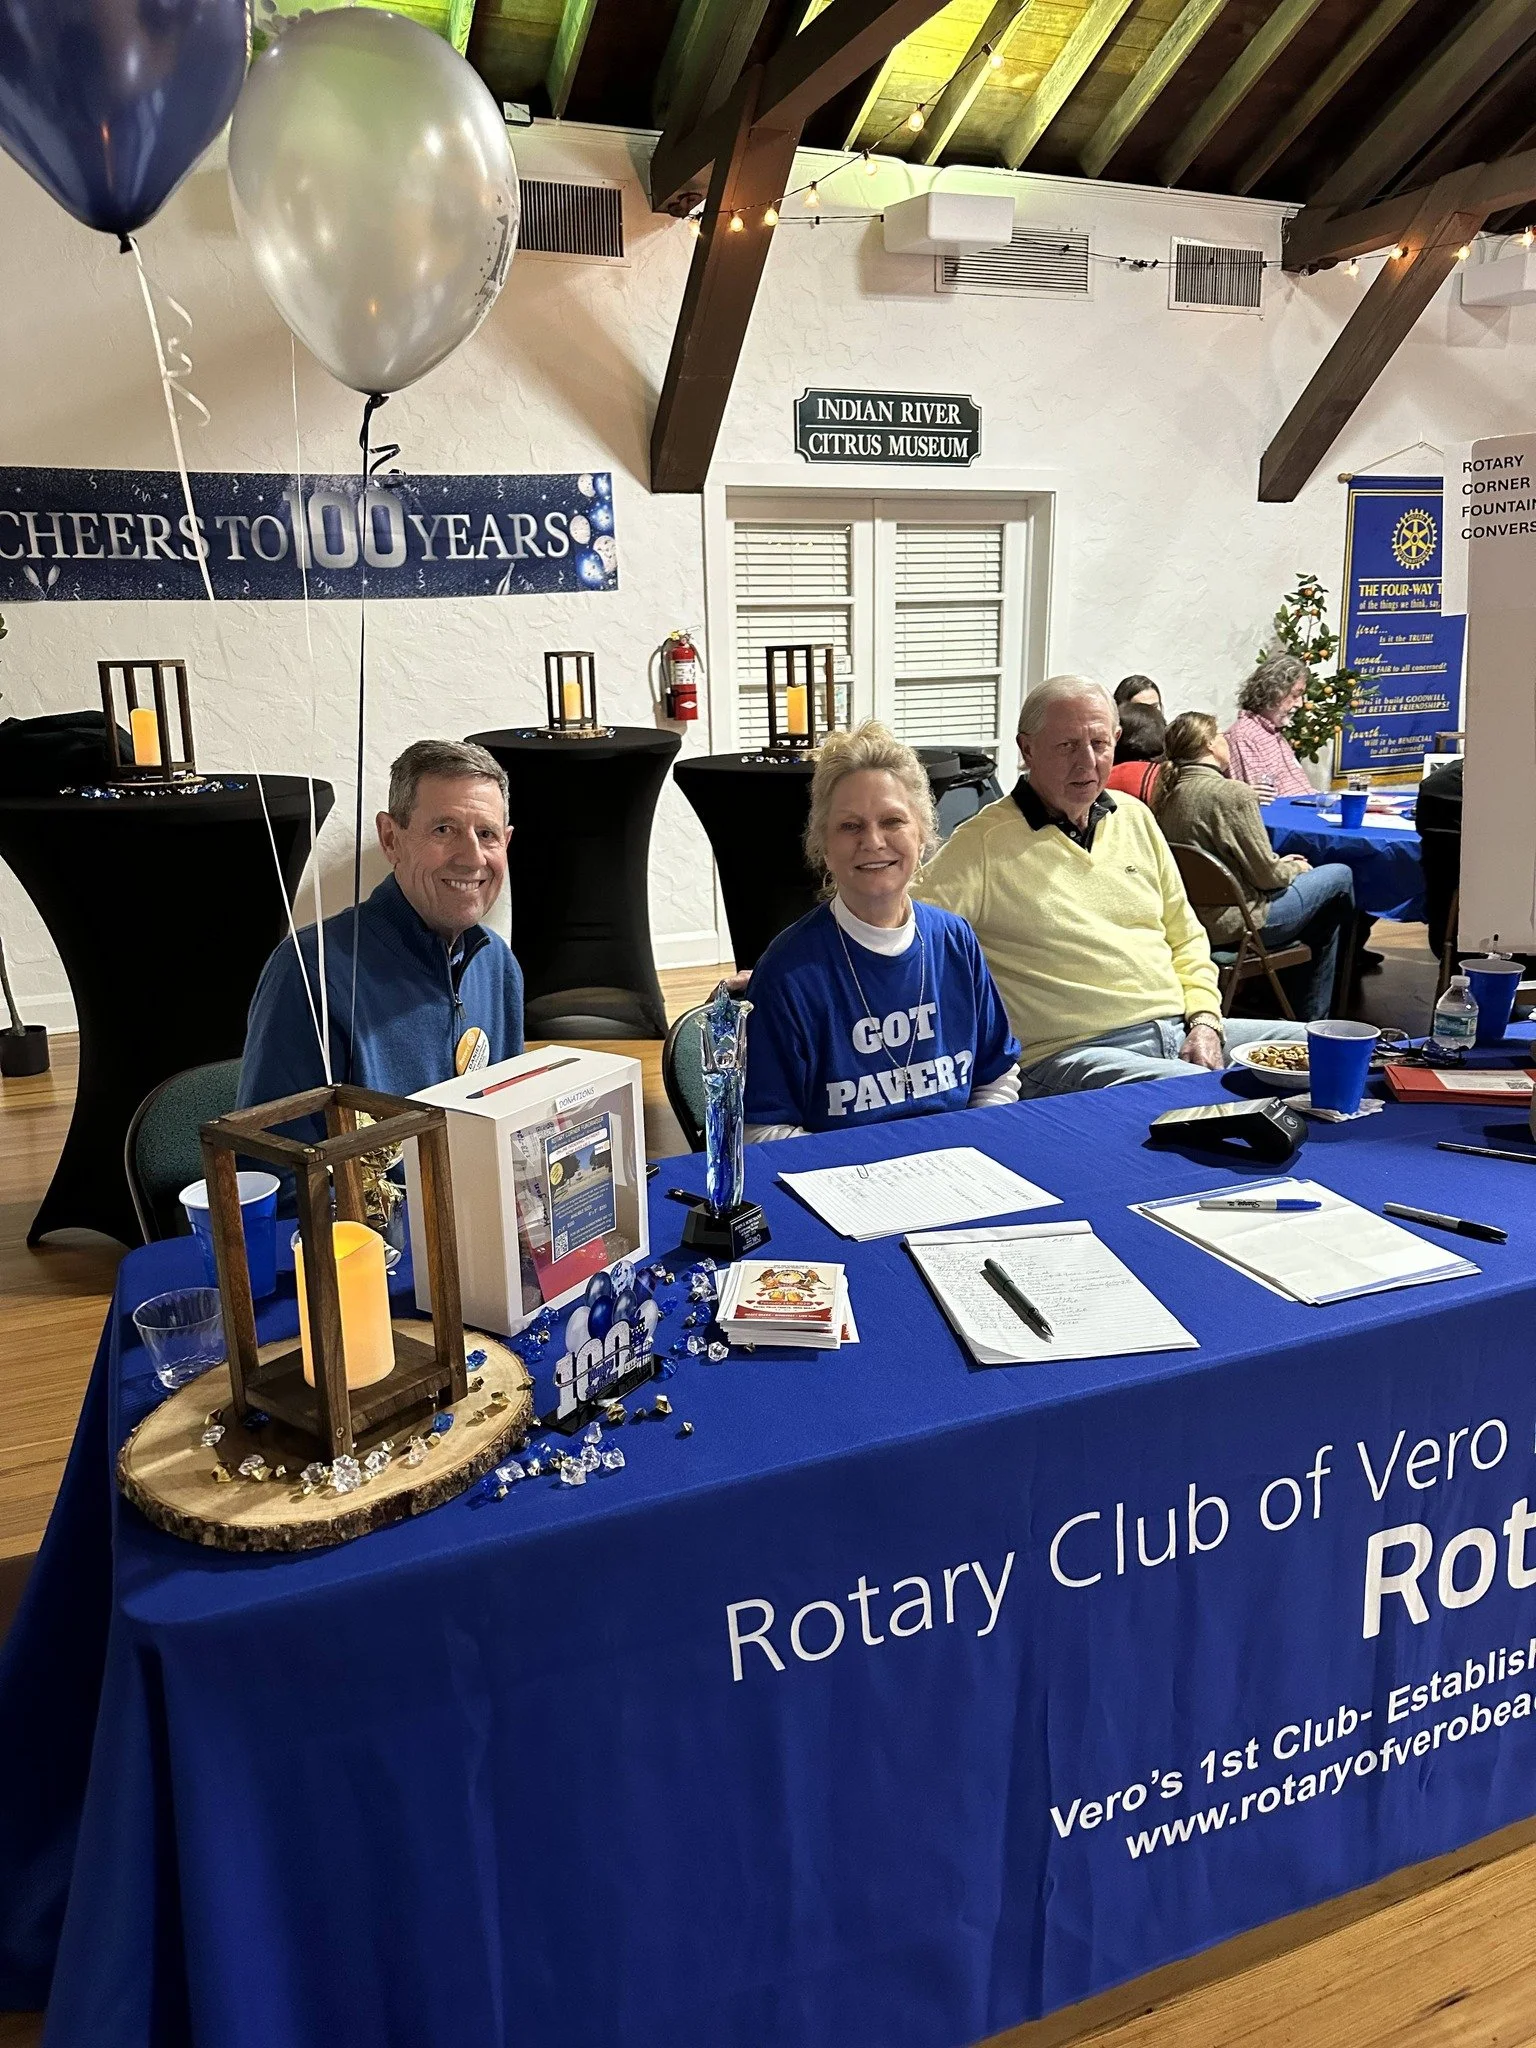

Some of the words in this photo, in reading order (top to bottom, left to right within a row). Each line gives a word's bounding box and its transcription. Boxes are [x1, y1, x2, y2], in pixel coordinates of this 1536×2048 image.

[817, 398, 894, 422] INDIAN
[901, 402, 961, 424] RIVER
[808, 432, 882, 456] CITRUS
[888, 435, 969, 458] MUSEUM
[1462, 455, 1524, 473] ROTARY
[1462, 477, 1530, 495] CORNER
[0, 511, 208, 561] CHEERS
[214, 514, 289, 562] TO
[282, 489, 408, 569] 100
[408, 511, 571, 562] YEARS
[1359, 584, 1380, 597] THE
[1381, 583, 1434, 597] FOUR-WAY
[1360, 600, 1366, 610] of
[1368, 600, 1378, 610] the
[1380, 599, 1399, 611] things
[1376, 665, 1392, 673] FAIR
[1401, 664, 1411, 672] all
[1368, 704, 1397, 713] BETTER
[1384, 695, 1404, 704] build
[1406, 693, 1445, 703] GOODWILL
[852, 1002, 937, 1054] GOT
[826, 1050, 973, 1116] PAVER?
[558, 1086, 595, 1109] DONATIONS
[726, 1551, 1015, 1681] Rotary
[1050, 1482, 1229, 1588] Club
[1259, 1444, 1333, 1531] of
[1356, 1419, 1508, 1502] Vero
[1362, 1497, 1536, 1639] Rot
[1200, 1737, 1260, 1784] 1st
[1272, 1703, 1373, 1760] Club-
[1125, 1692, 1536, 1860] www.rotaryofverobea
